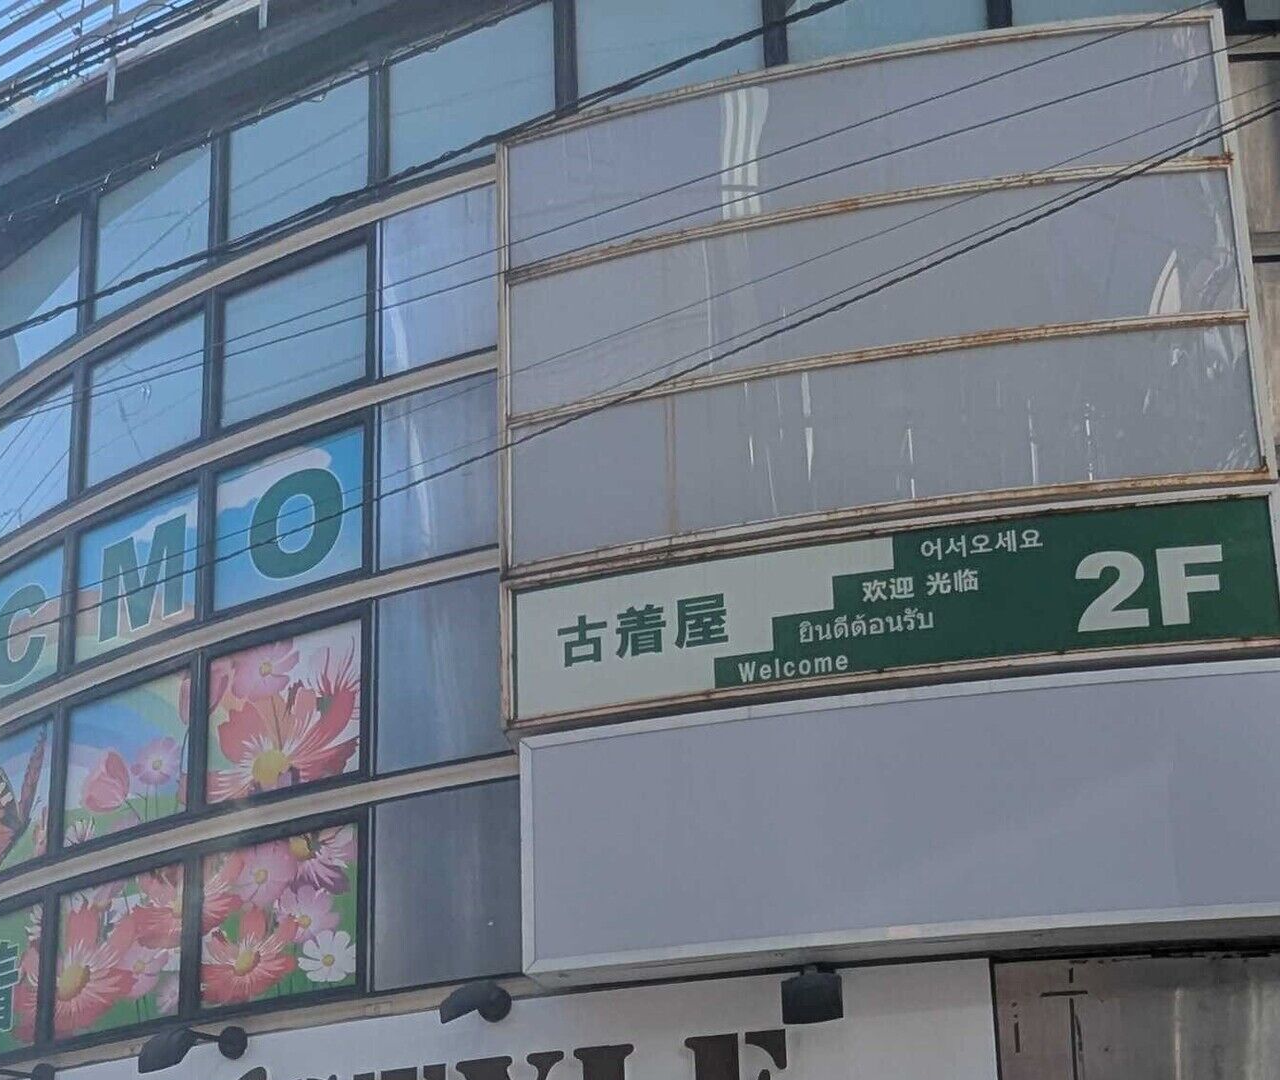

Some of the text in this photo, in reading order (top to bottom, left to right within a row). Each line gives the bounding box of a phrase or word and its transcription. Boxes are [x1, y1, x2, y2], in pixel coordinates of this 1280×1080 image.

[919, 527, 1044, 561] 어서오세요
[861, 568, 980, 604] 欢迎 光临
[1073, 543, 1226, 633] 2F
[556, 592, 731, 669] 古着屋
[798, 608, 935, 645] ยินดีต้อนรับ
[738, 653, 850, 685] Welcome
